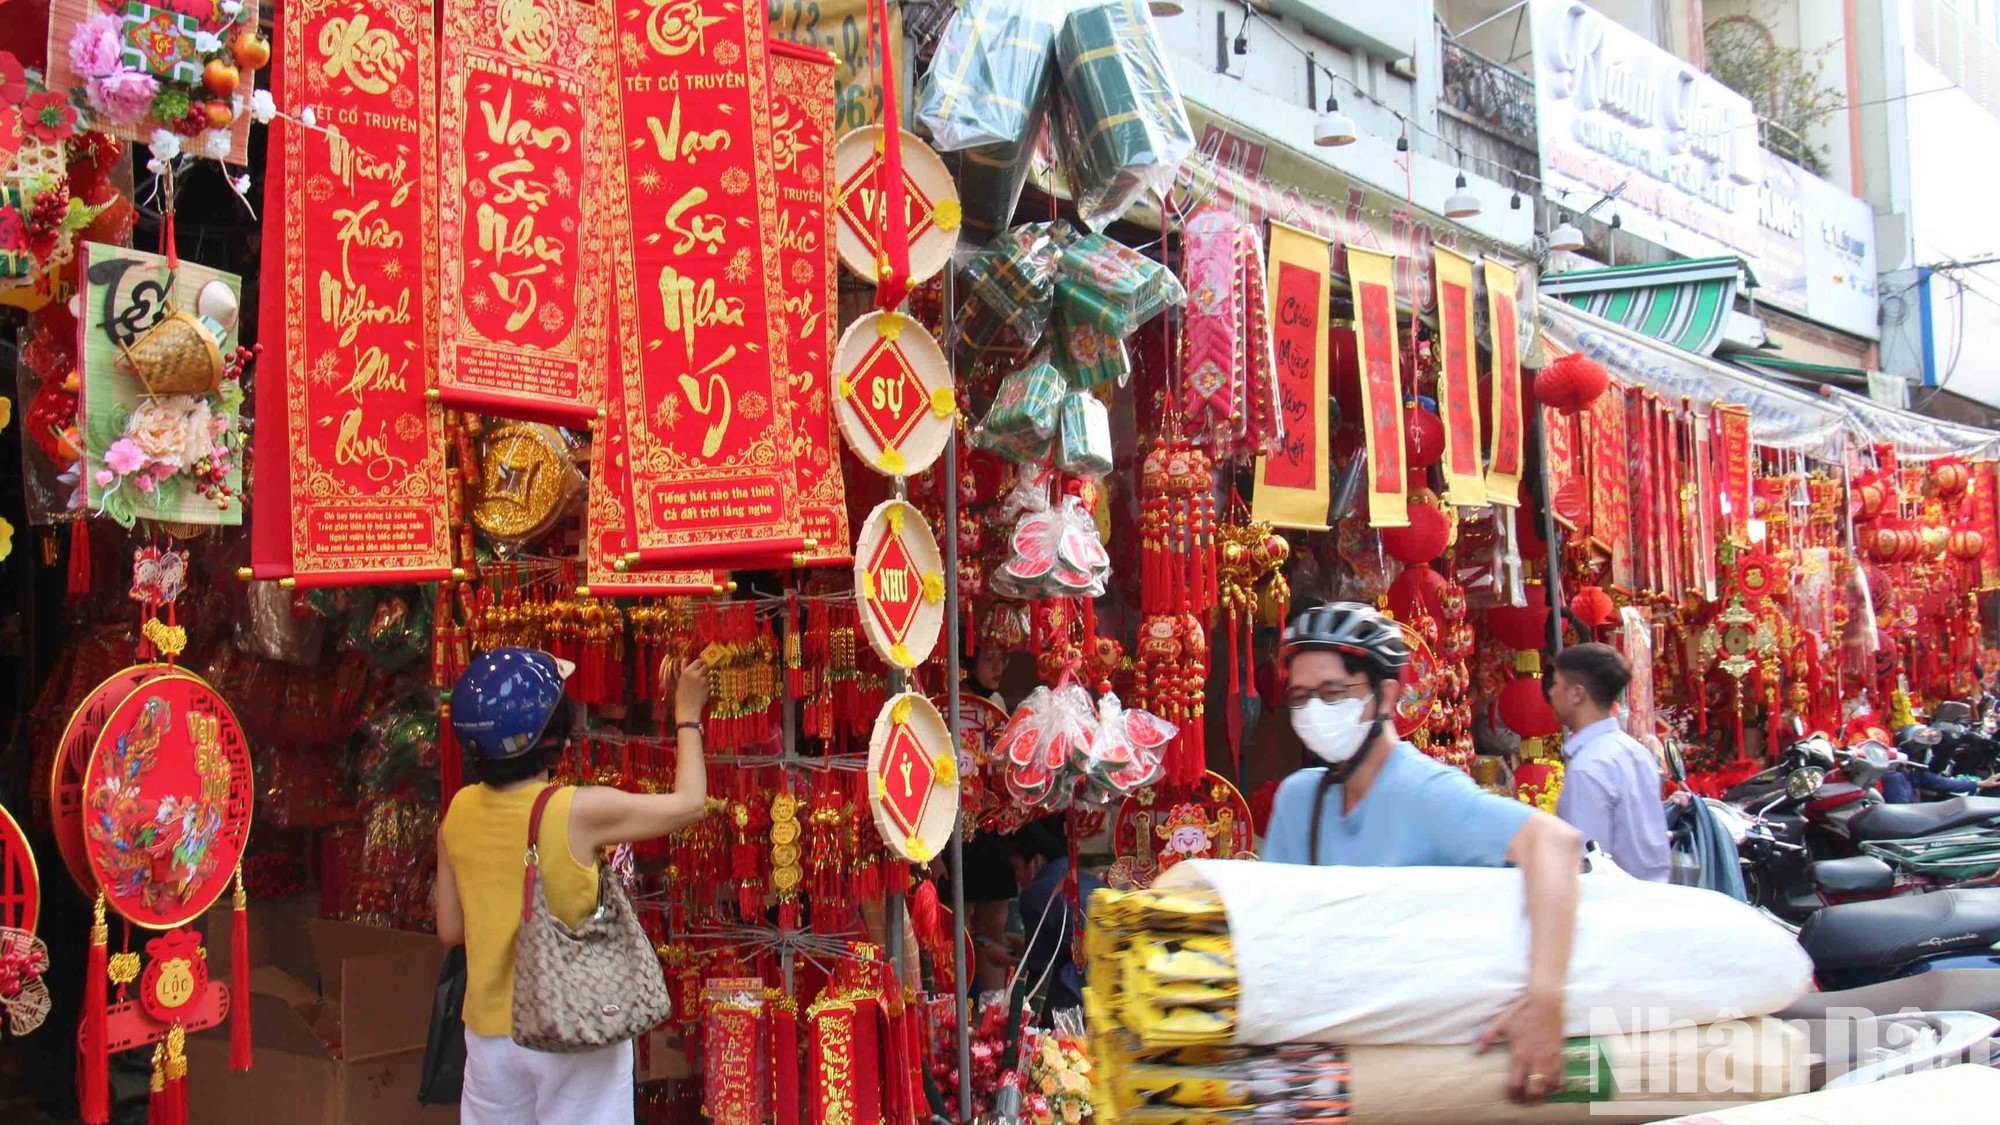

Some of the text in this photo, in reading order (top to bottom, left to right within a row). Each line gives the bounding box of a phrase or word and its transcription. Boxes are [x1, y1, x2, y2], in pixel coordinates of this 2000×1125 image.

[625, 74, 651, 92] TẾT
[647, 93, 731, 165] Vạn
[665, 187, 727, 256] Sự
[333, 200, 404, 291] Xuân
[658, 265, 745, 367] Như
[872, 373, 905, 420] SỰ
[657, 485, 775, 504] Tiếng hát nào tha thiết
[663, 508, 678, 521] Cả
[700, 504, 719, 518] trời
[748, 503, 772, 517] nghe
[880, 565, 909, 602] NHƯ
[900, 752, 912, 797] Ý
[162, 973, 189, 1001] LỘC
